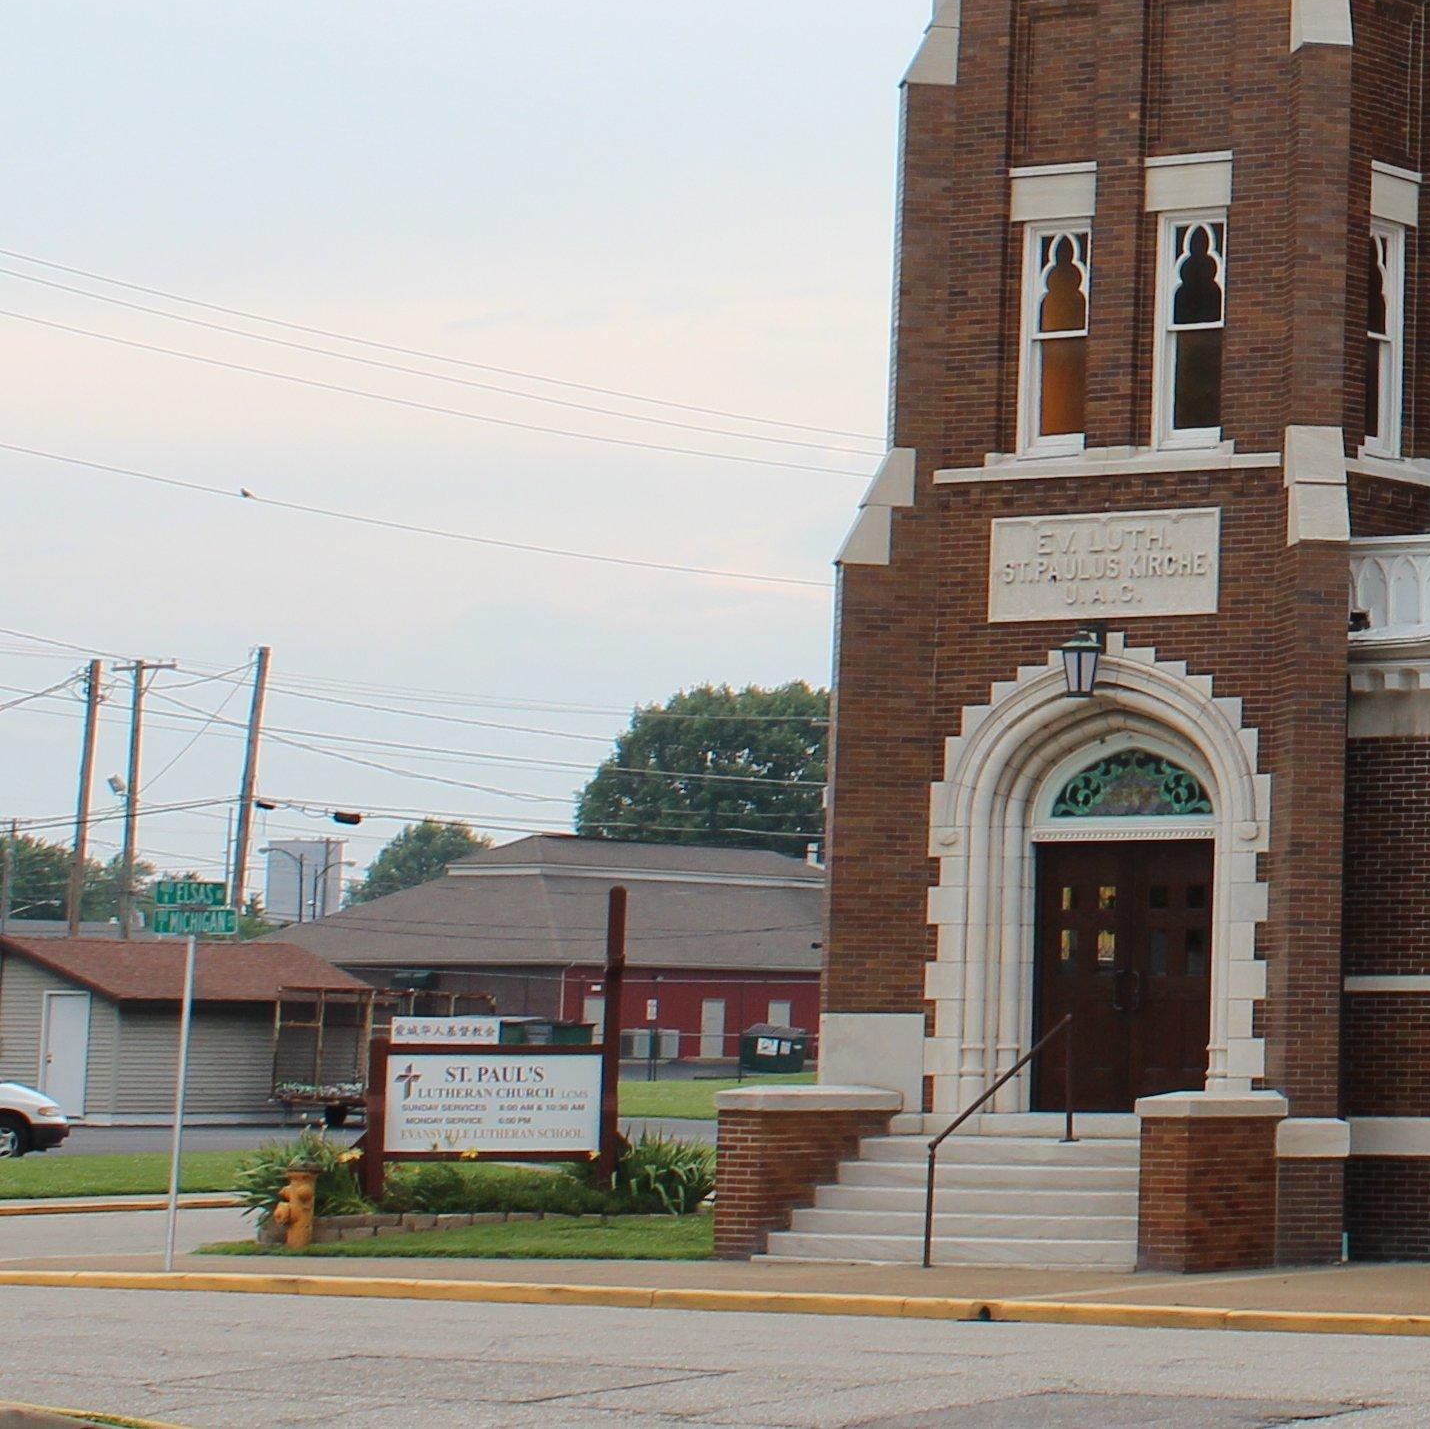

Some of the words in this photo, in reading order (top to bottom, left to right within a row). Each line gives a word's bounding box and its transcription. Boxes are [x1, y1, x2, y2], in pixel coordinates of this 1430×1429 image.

[1088, 526, 1173, 552] LUTH.
[169, 911, 226, 932] MICHIGAN
[445, 1067, 470, 1083] ST.
[478, 1066, 544, 1083] PAUL'S
[417, 1087, 493, 1099] LUTHERAN
[496, 1087, 554, 1098] CHURCH
[561, 1090, 588, 1098] LCMS
[473, 1128, 535, 1139] LUTHERAN
[537, 1128, 584, 1139] SCHOOL
